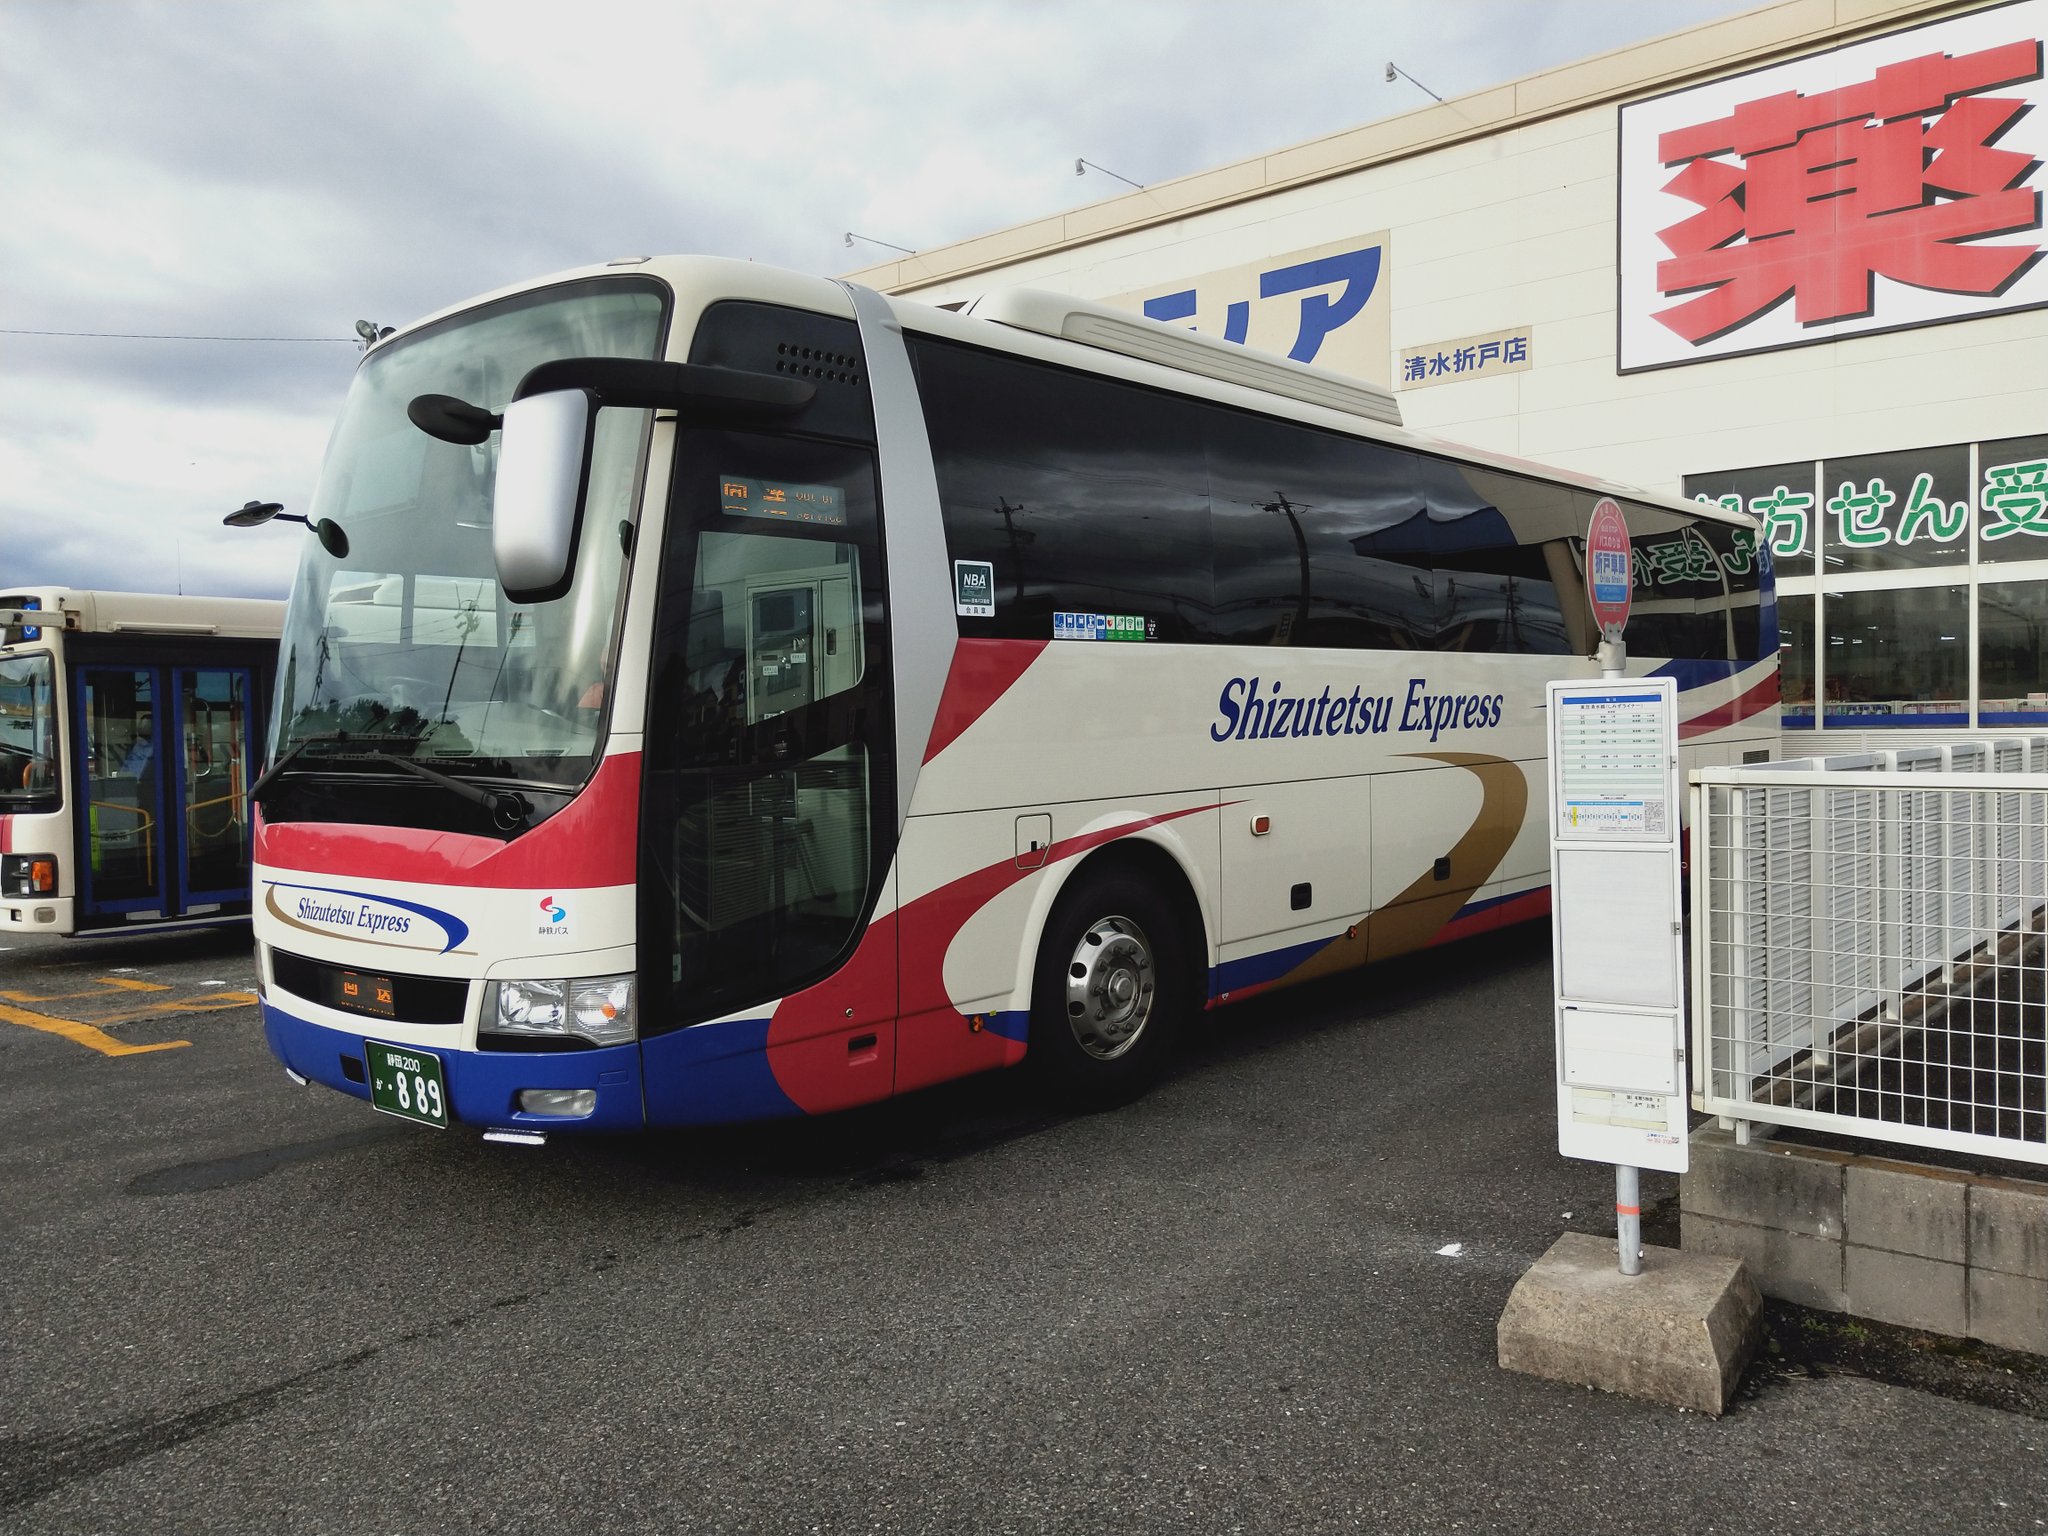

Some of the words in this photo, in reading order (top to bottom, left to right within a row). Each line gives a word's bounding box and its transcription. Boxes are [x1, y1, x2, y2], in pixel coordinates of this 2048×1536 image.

[1648, 38, 2044, 347] 薬
[1404, 336, 1528, 382] 清水折戸店
[964, 573, 986, 587] NBA
[1595, 551, 1626, 575] 折戸車庫
[1211, 676, 1394, 742] Shizutetsu
[1398, 678, 1504, 743] Express
[297, 897, 355, 926] Shizutetsu
[357, 905, 411, 934] Express
